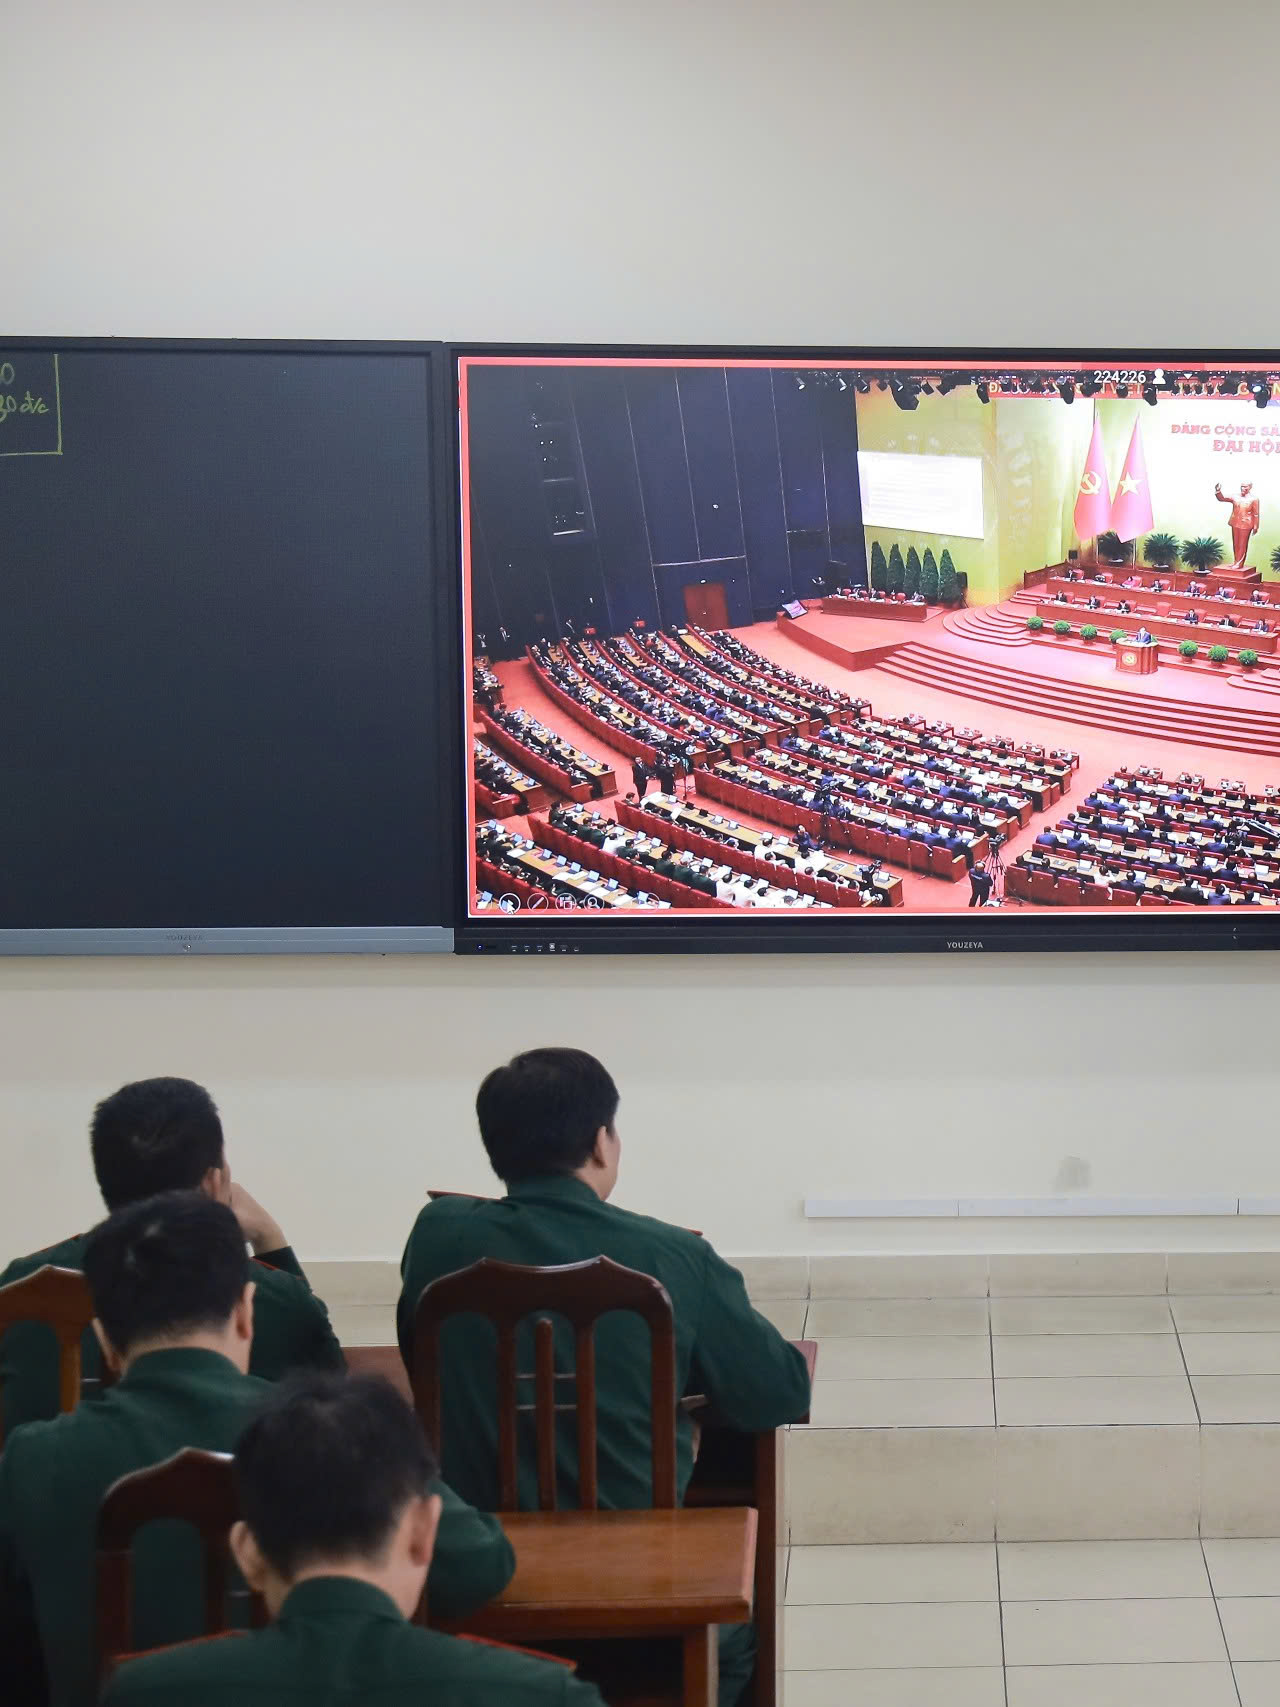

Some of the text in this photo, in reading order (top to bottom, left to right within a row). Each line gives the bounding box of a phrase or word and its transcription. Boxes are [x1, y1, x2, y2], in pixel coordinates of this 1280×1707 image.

[1093, 370, 1147, 384] 224226
[1214, 423, 1256, 438] CỘNG
[1213, 439, 1244, 455] ĐẠI
[1248, 438, 1280, 456] HỘI
[946, 941, 984, 949] YOUZEYA
